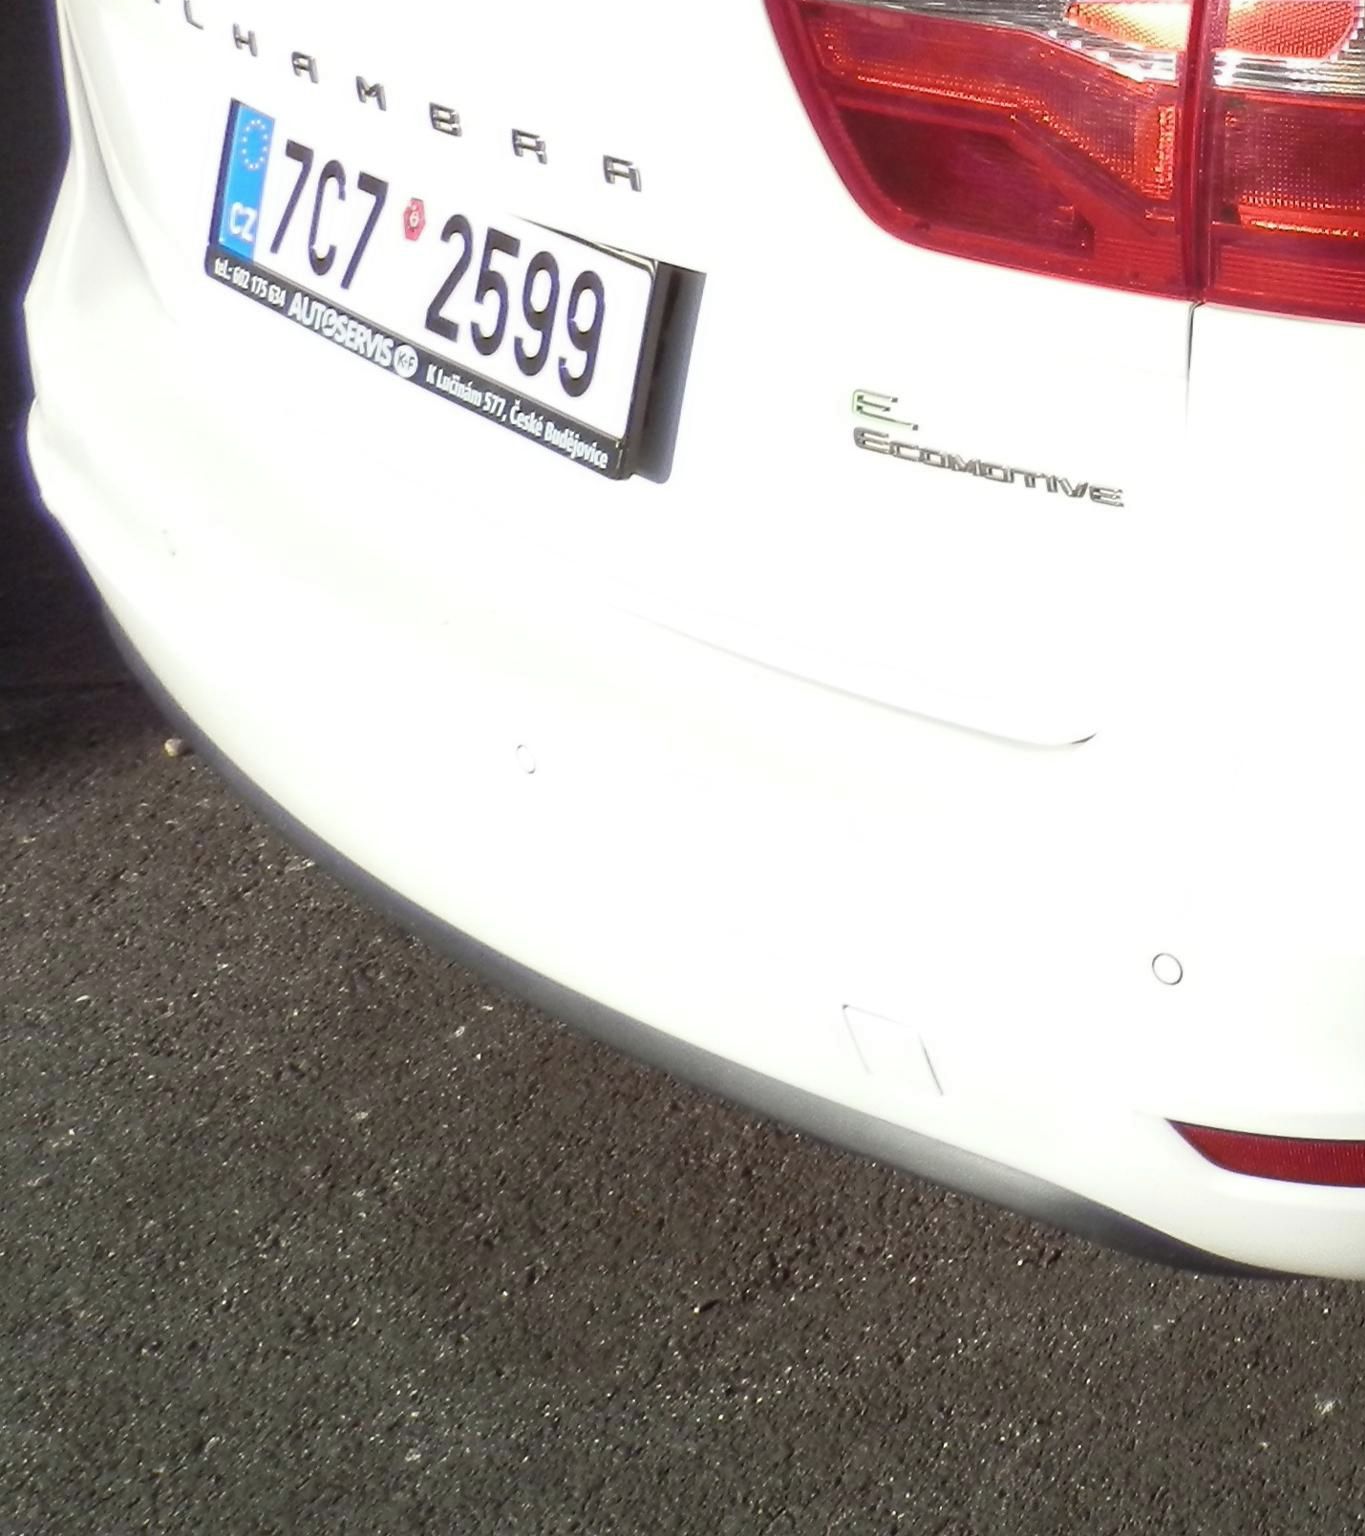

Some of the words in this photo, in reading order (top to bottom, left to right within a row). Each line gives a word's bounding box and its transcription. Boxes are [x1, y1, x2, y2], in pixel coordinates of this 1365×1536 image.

[229, 201, 258, 242] CZ
[270, 138, 389, 291] 7C7
[425, 213, 606, 398] 2599
[251, 275, 268, 299] 175
[288, 292, 394, 367] AUTOSERVIS
[425, 364, 437, 384] K
[510, 399, 544, 437] České
[544, 421, 609, 469] Budějovice
[853, 426, 1125, 508] ECOMOTIVE
